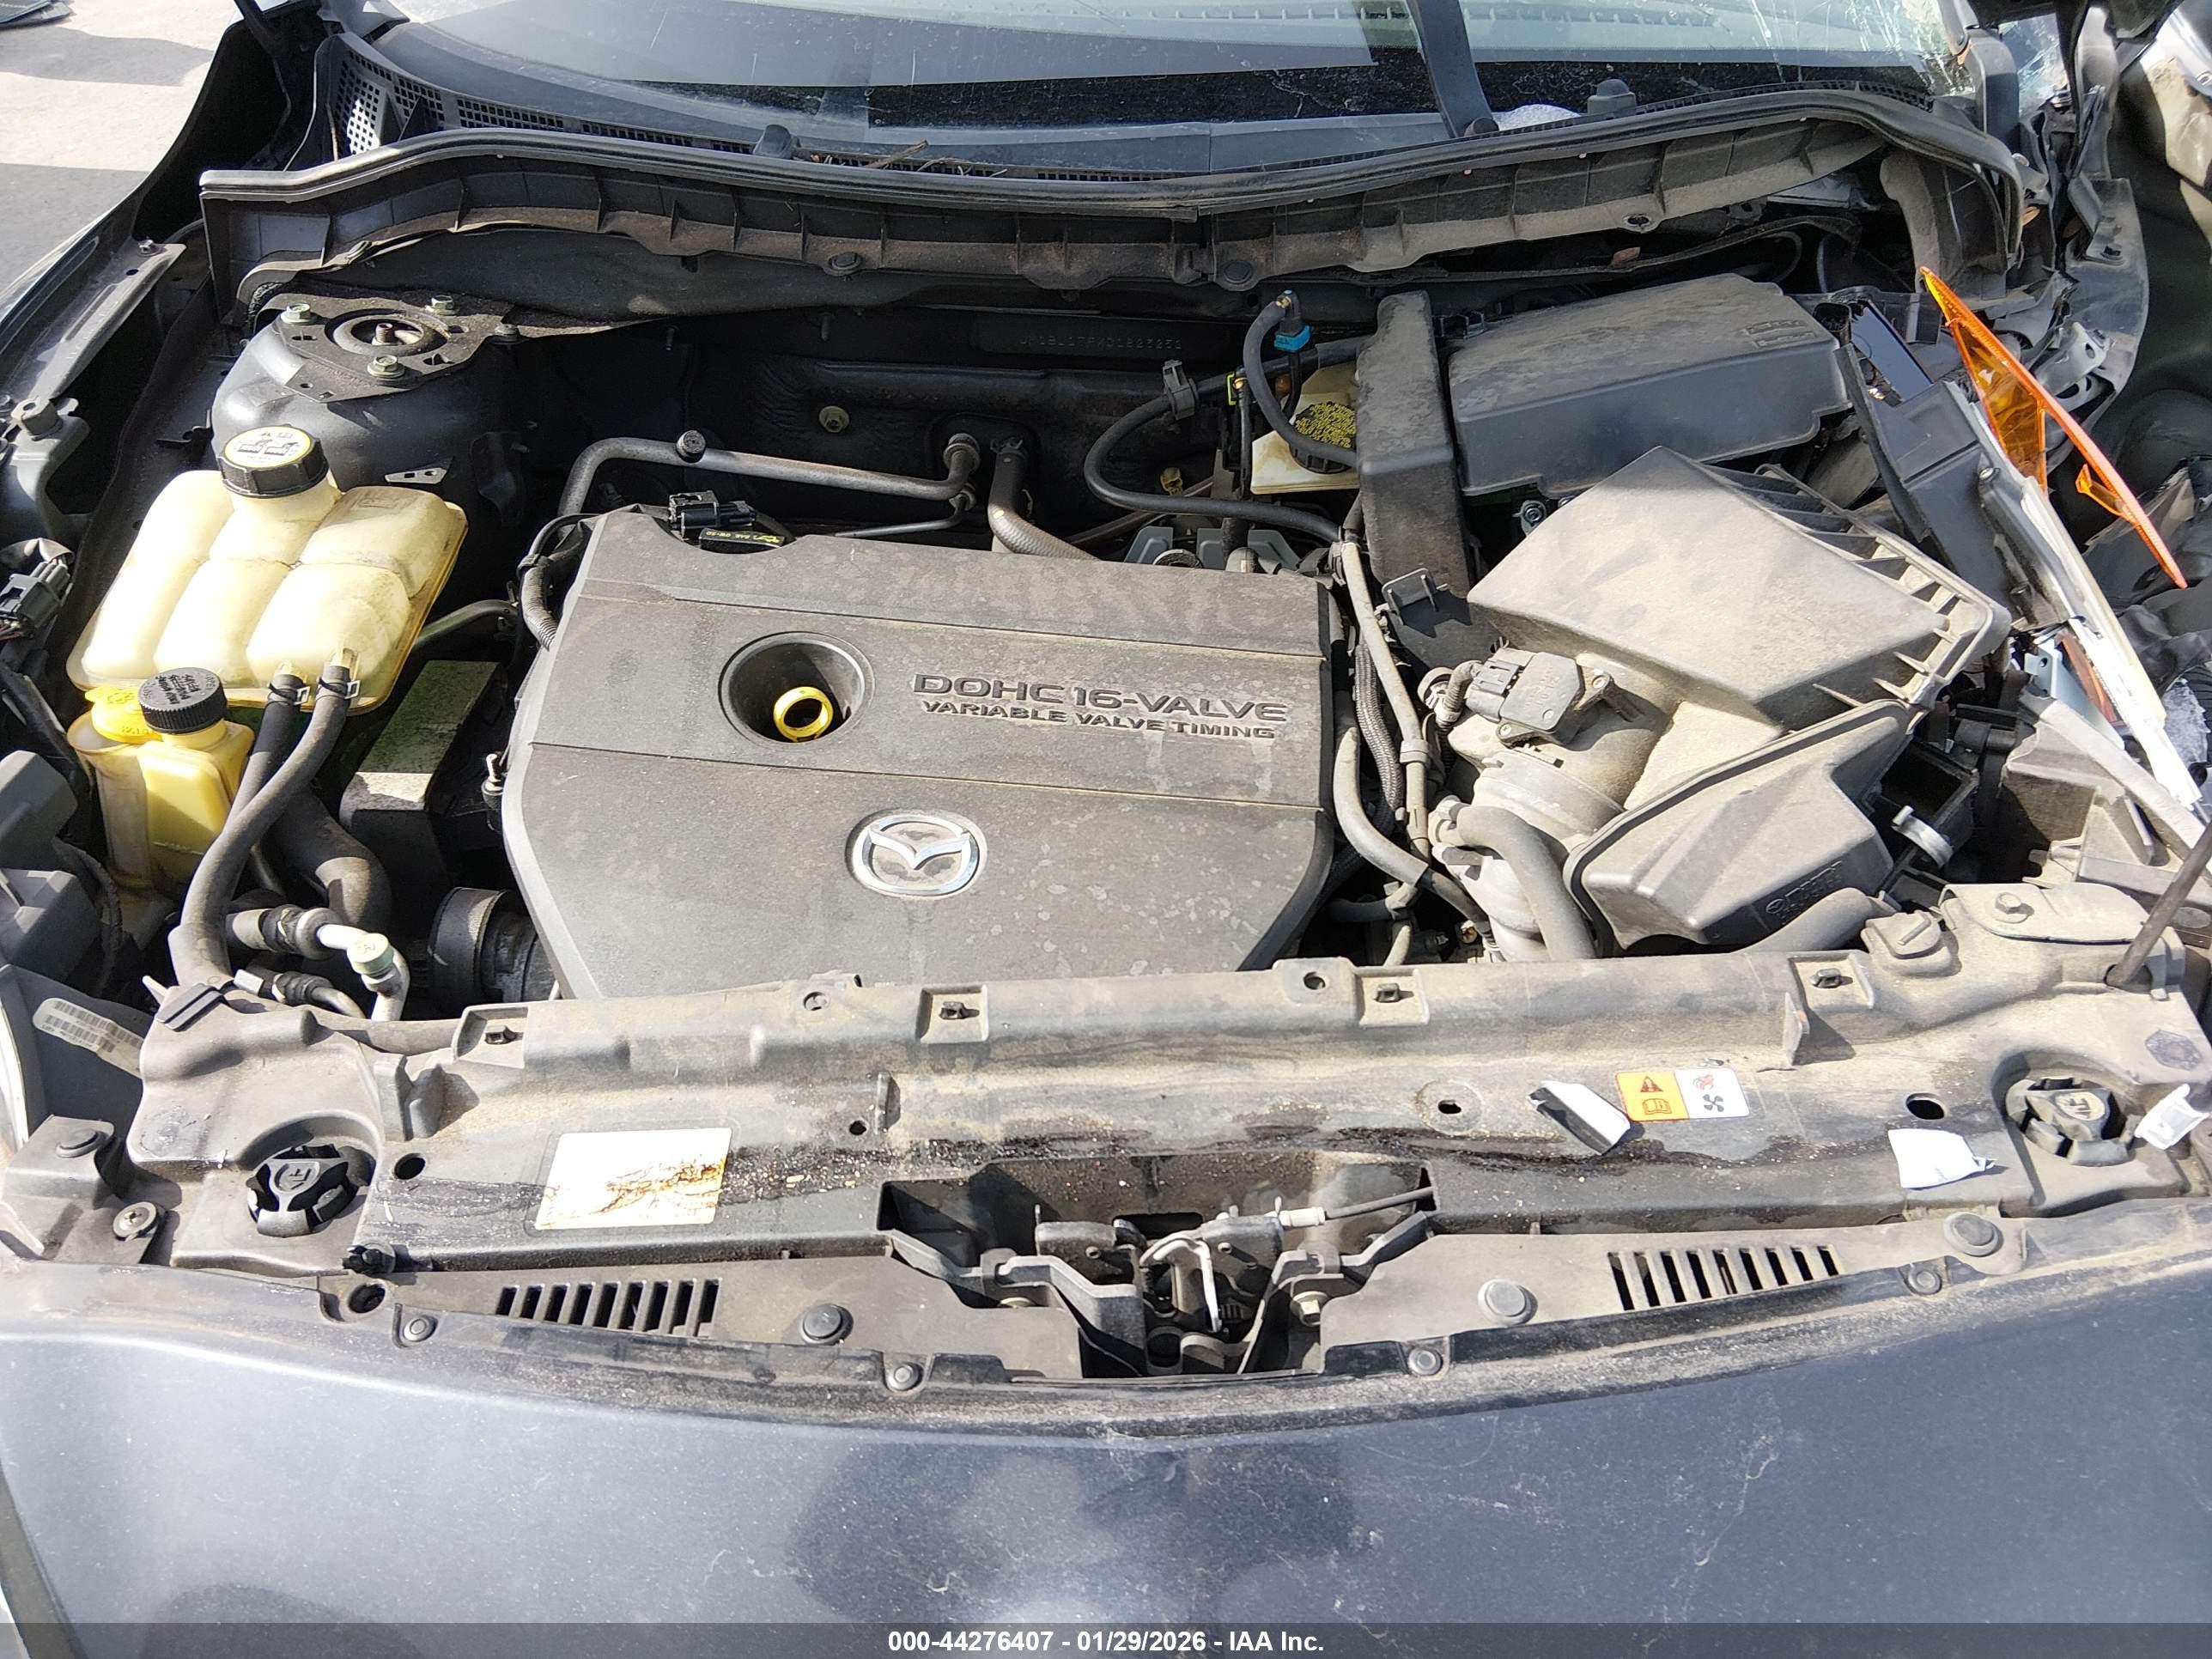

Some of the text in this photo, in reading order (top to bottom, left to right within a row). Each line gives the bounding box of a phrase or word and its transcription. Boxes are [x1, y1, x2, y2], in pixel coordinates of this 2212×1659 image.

[914, 673, 1287, 722] DOHC 16-VALVE
[922, 700, 1275, 738] VARIABLE VALVE TIMING
